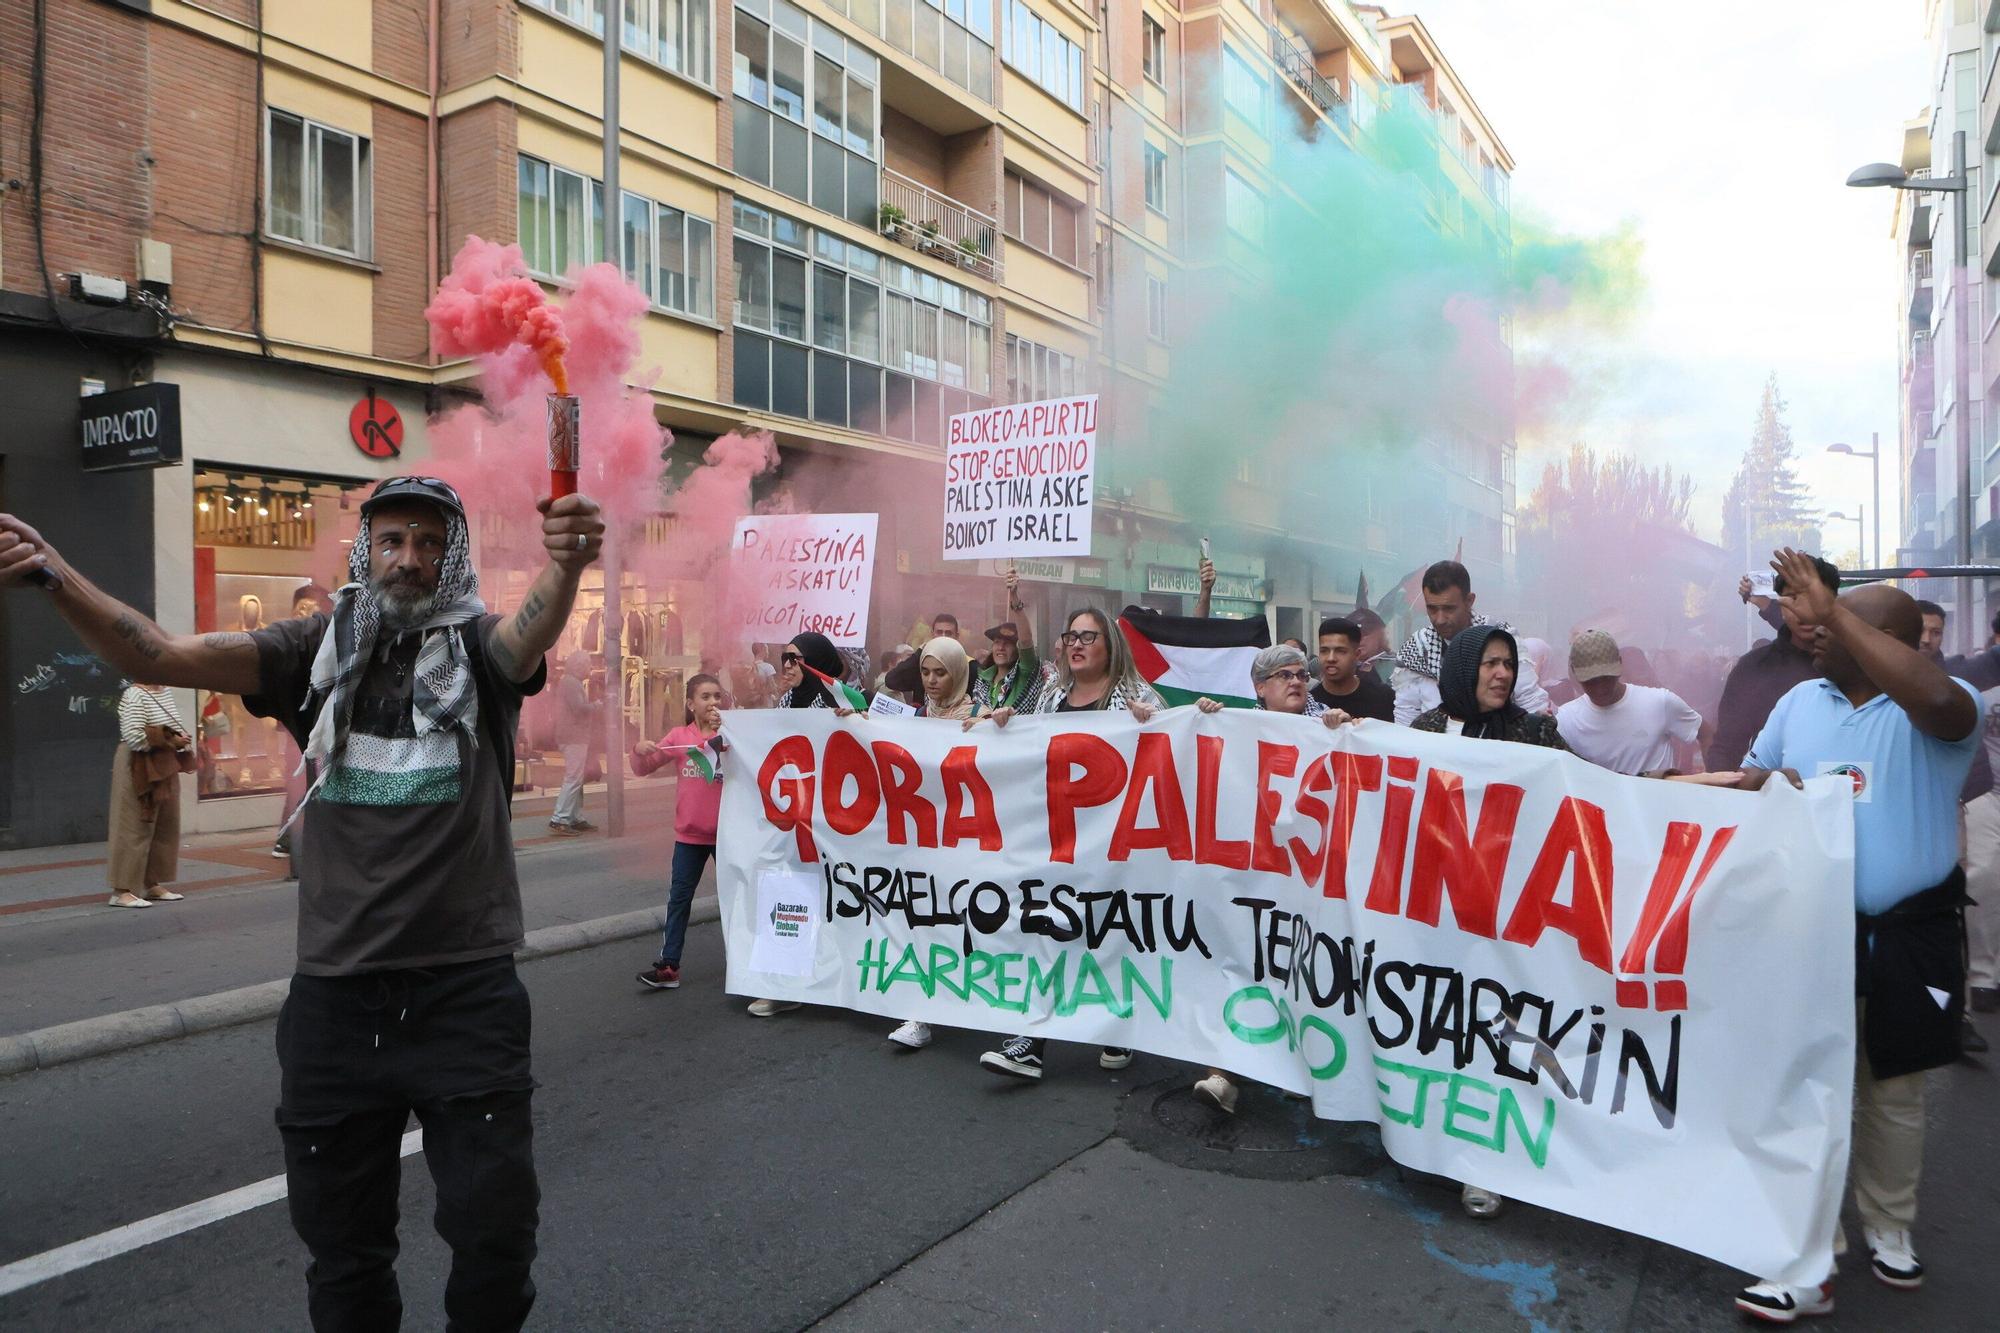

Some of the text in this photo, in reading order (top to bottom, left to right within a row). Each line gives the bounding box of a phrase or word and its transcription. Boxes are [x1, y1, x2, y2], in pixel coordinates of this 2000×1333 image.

[82, 407, 158, 448] IMPACTO
[946, 474, 1089, 514] PALESTINA ASKE
[945, 512, 1079, 550] BOIKOT ISRAEL
[757, 730, 1003, 863] GORA
[775, 921, 799, 931] Globala
[777, 902, 808, 914] Gazarako
[1018, 878, 1213, 960] ESTATU
[855, 936, 1174, 1021] HARREMAN
[1373, 1056, 1556, 1169] ETEN
